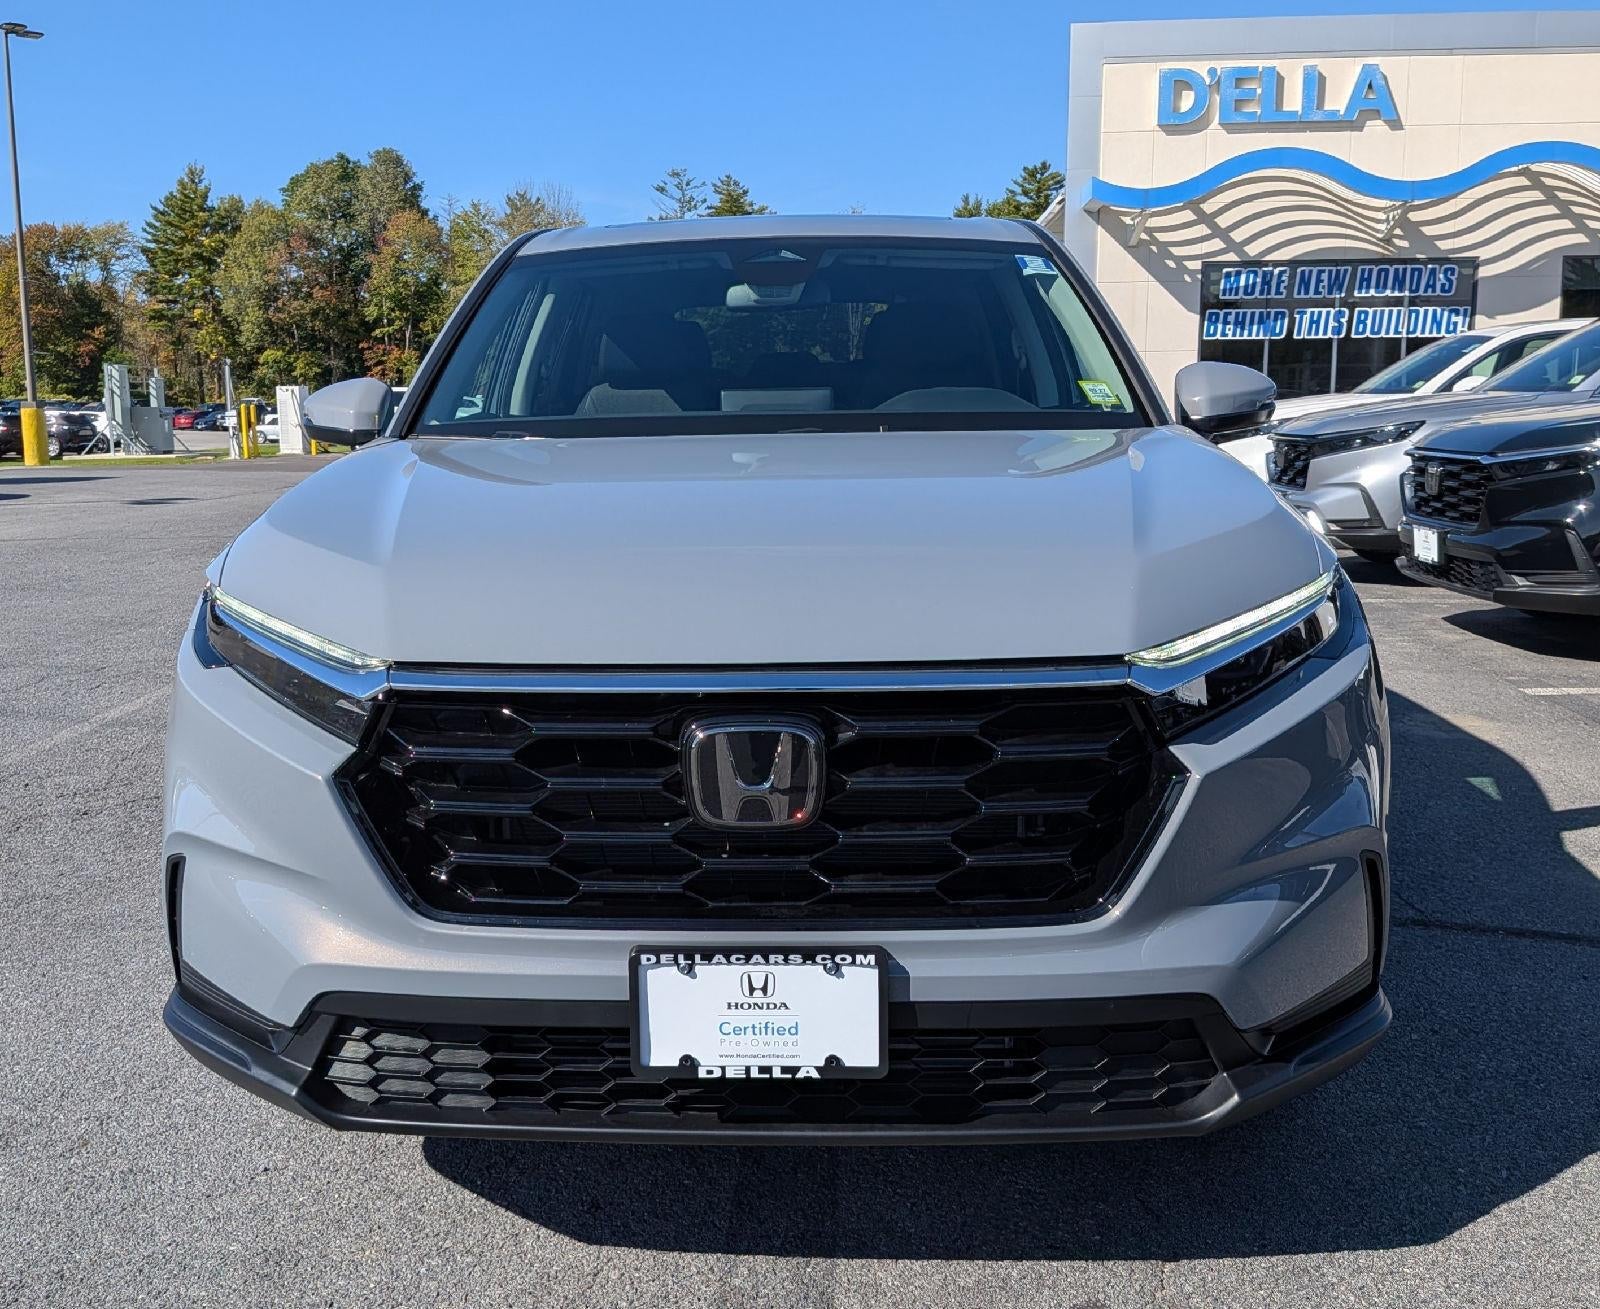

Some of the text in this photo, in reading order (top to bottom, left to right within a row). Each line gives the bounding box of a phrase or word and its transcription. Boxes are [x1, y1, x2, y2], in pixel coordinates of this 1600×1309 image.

[1157, 64, 1399, 125] D'ELLA
[1219, 264, 1458, 299] MORE NEW HONDAS
[1203, 306, 1471, 339] BEHIND THIS BUILDING!
[640, 953, 876, 966] DELLACARS.COM
[726, 1001, 791, 1011] HONDA
[718, 1021, 799, 1036] Certified
[718, 1052, 801, 1060] www.HondaCertified.com
[697, 1066, 821, 1080] DELLA
